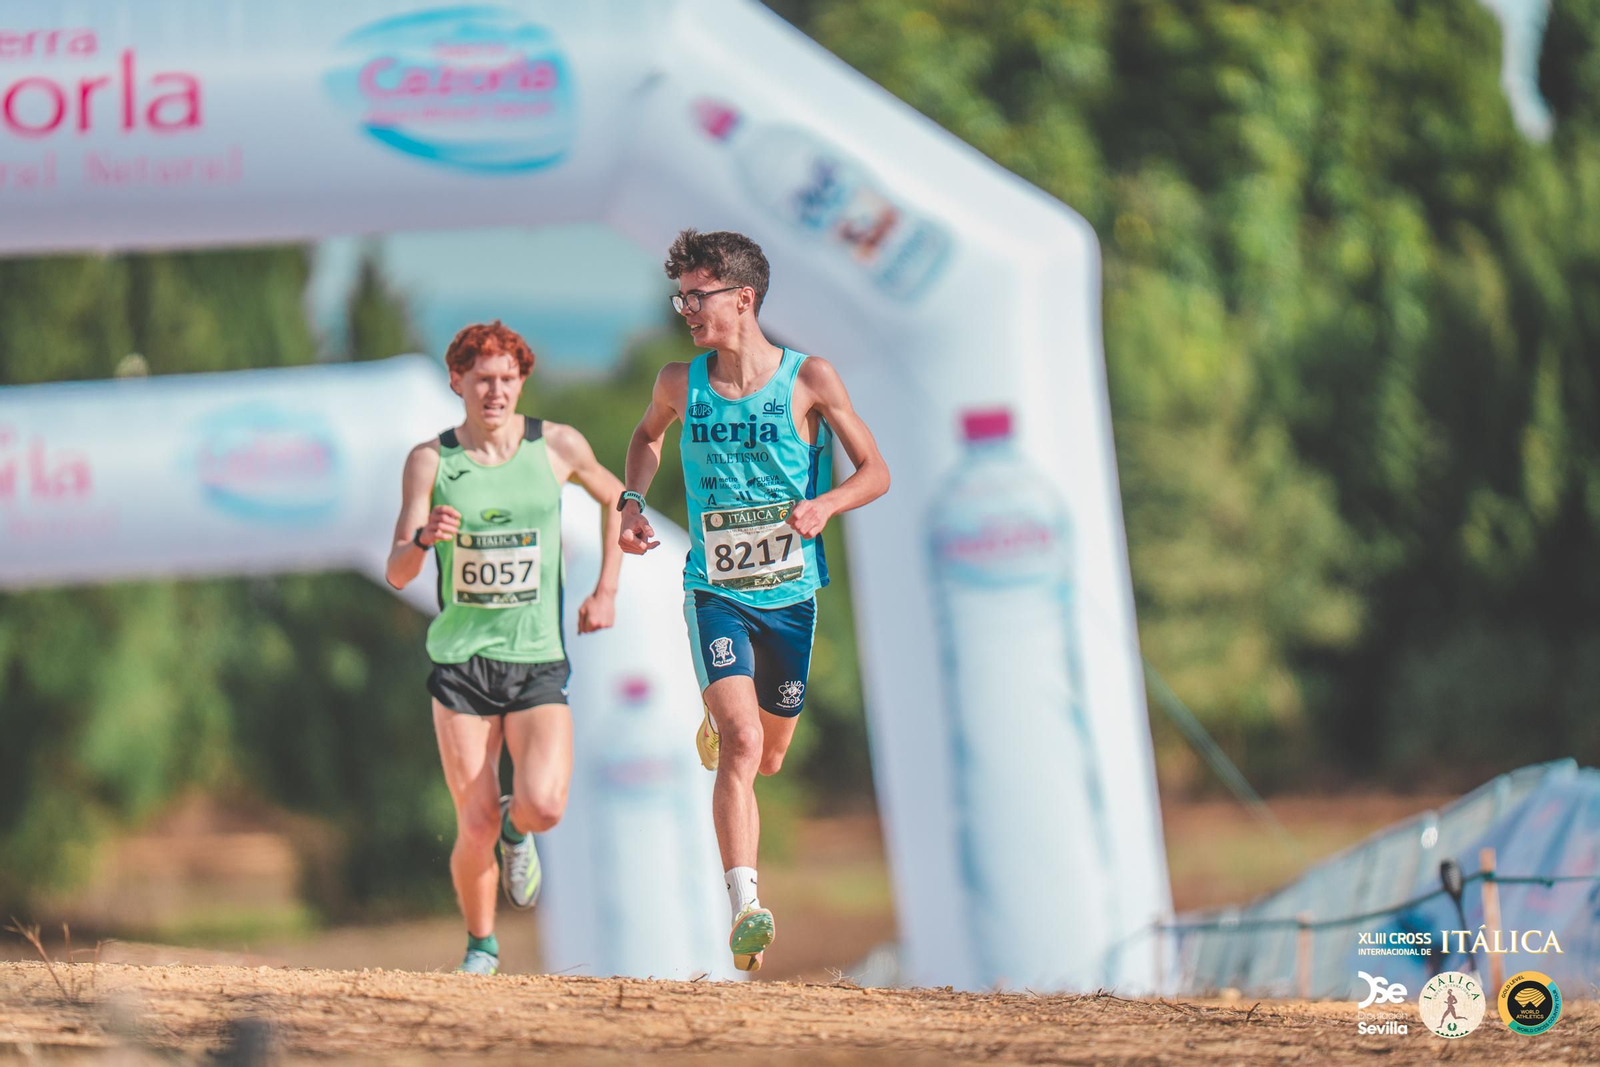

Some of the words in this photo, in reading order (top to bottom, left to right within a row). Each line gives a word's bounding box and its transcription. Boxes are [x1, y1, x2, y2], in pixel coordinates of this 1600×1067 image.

[691, 414, 779, 449] nerja
[706, 451, 769, 464] ATLETISMO
[756, 475, 780, 483] CUEVA
[728, 509, 773, 524] ITÁLICA
[714, 533, 794, 572] 8217
[461, 560, 534, 585] 6057
